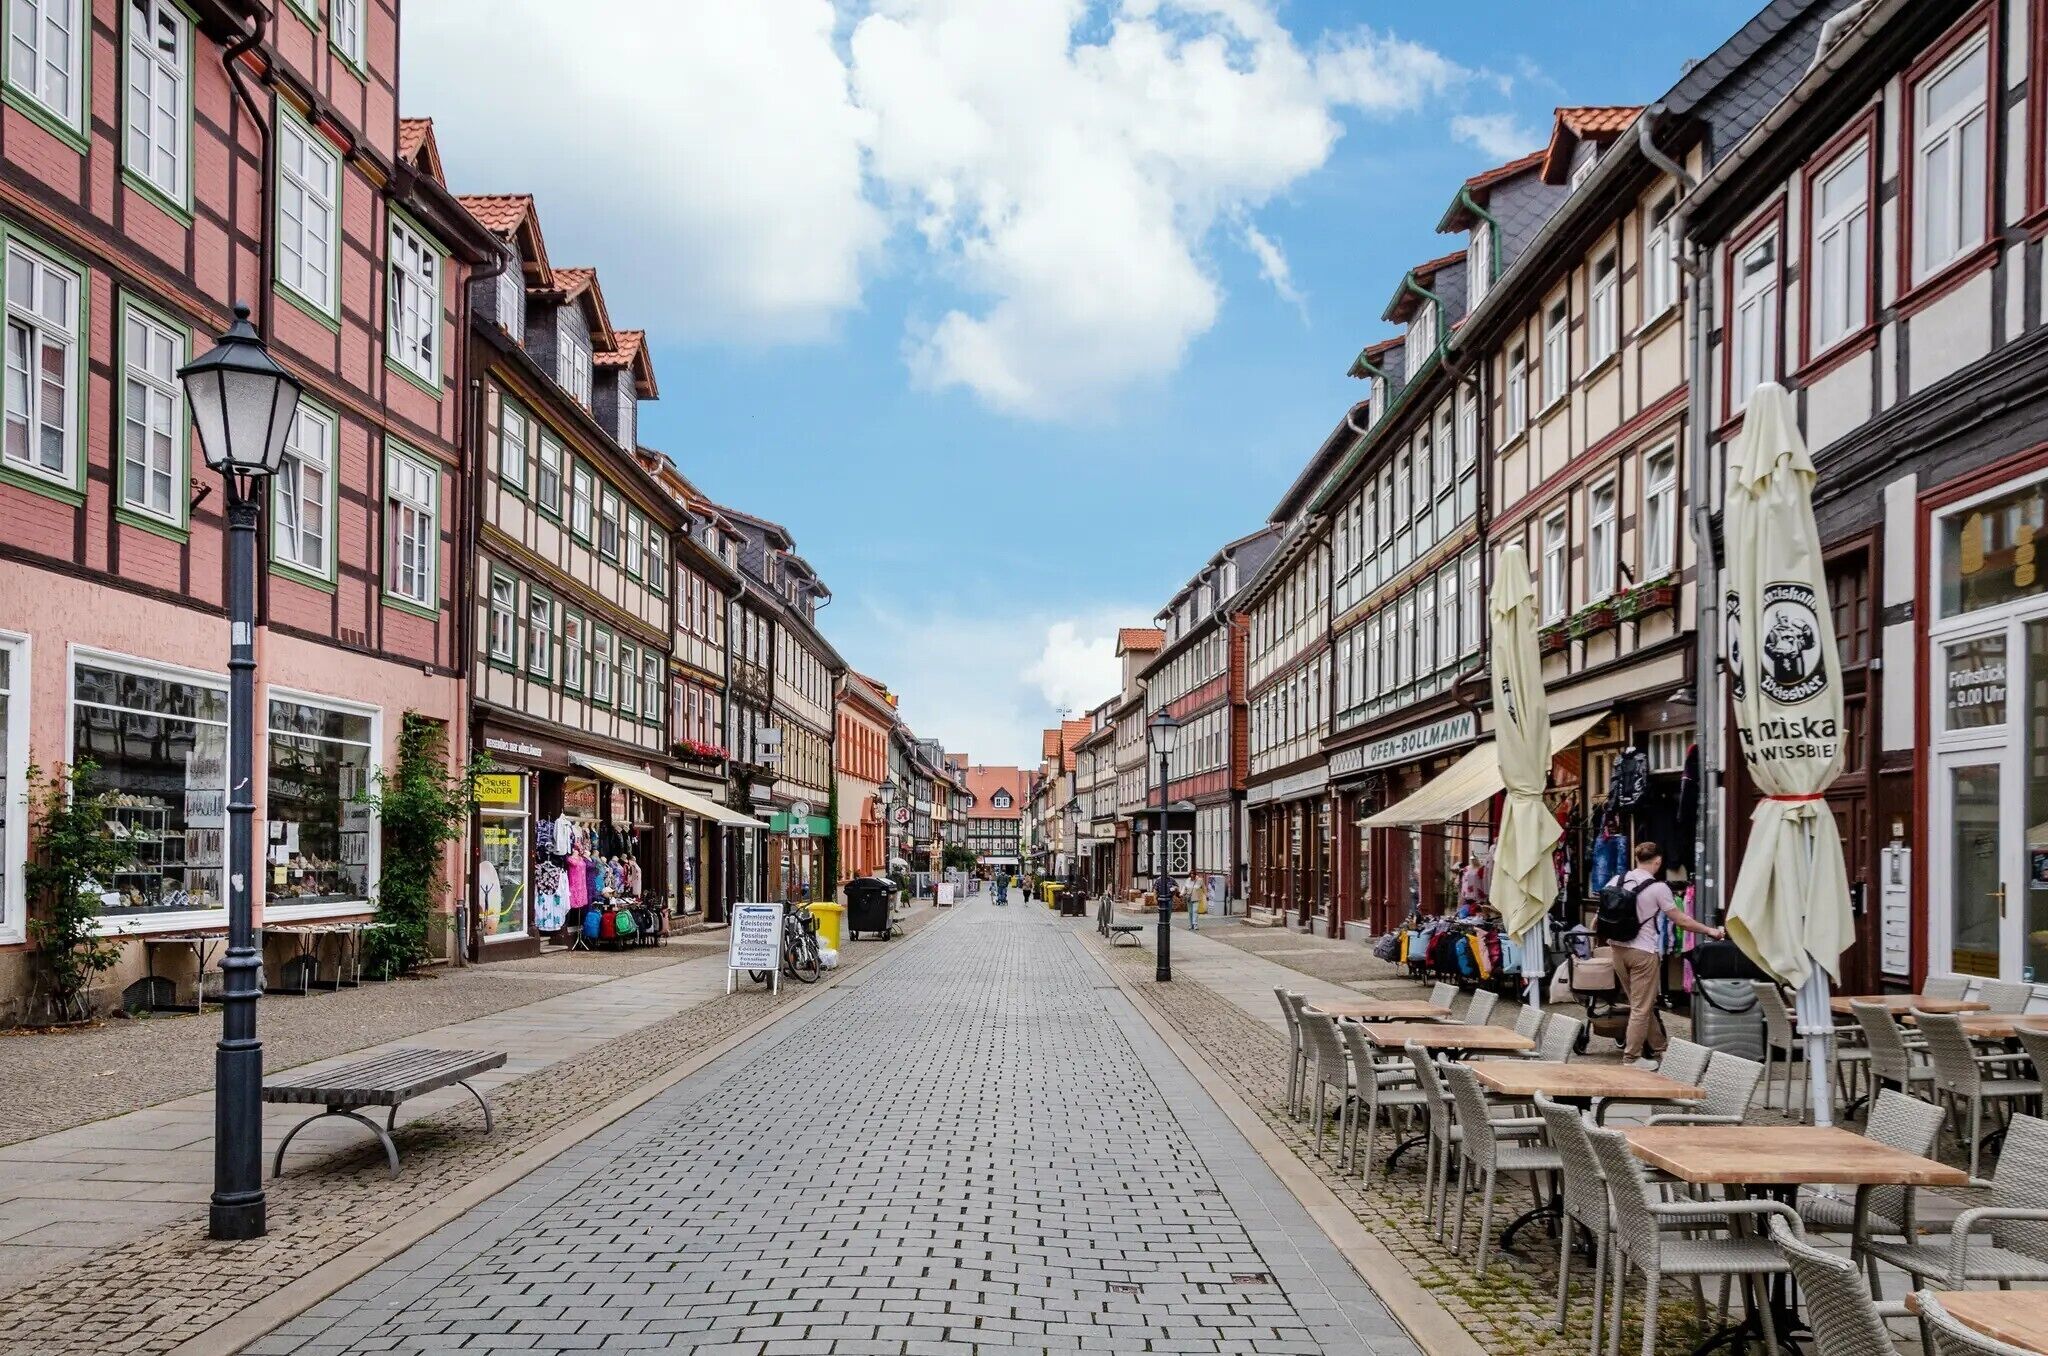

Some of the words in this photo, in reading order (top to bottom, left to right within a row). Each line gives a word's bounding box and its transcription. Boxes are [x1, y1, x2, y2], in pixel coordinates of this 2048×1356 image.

[1761, 675, 1824, 700] Weissbier
[1949, 664, 2005, 688] Frühstück
[1984, 685, 2006, 703] Uhr
[1371, 716, 1470, 761] OFEN-BOLLMANN
